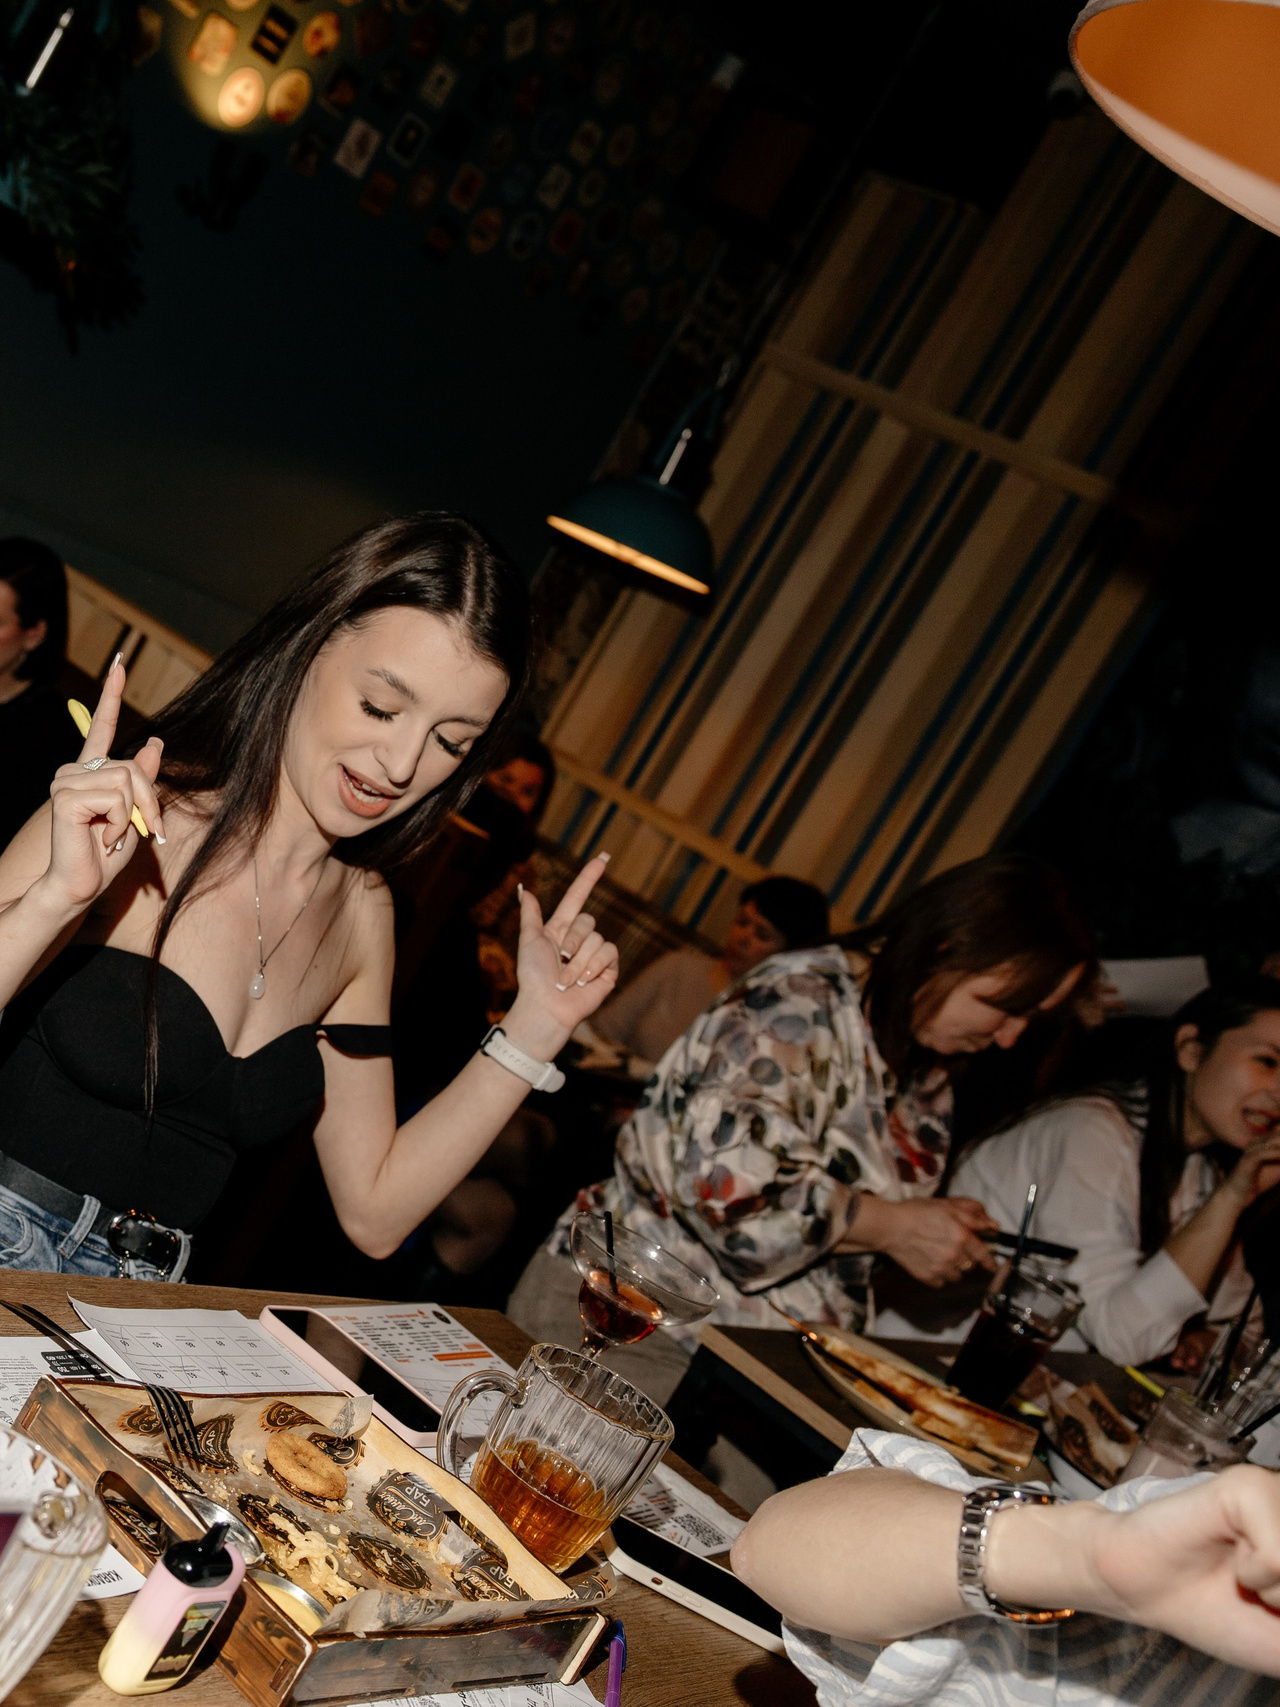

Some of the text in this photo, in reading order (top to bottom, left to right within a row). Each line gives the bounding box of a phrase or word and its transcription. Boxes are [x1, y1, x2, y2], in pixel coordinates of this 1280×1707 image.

[404, 1485, 431, 1507] БАР
[128, 1515, 158, 1536] БАР
[489, 1565, 515, 1589] БАР
